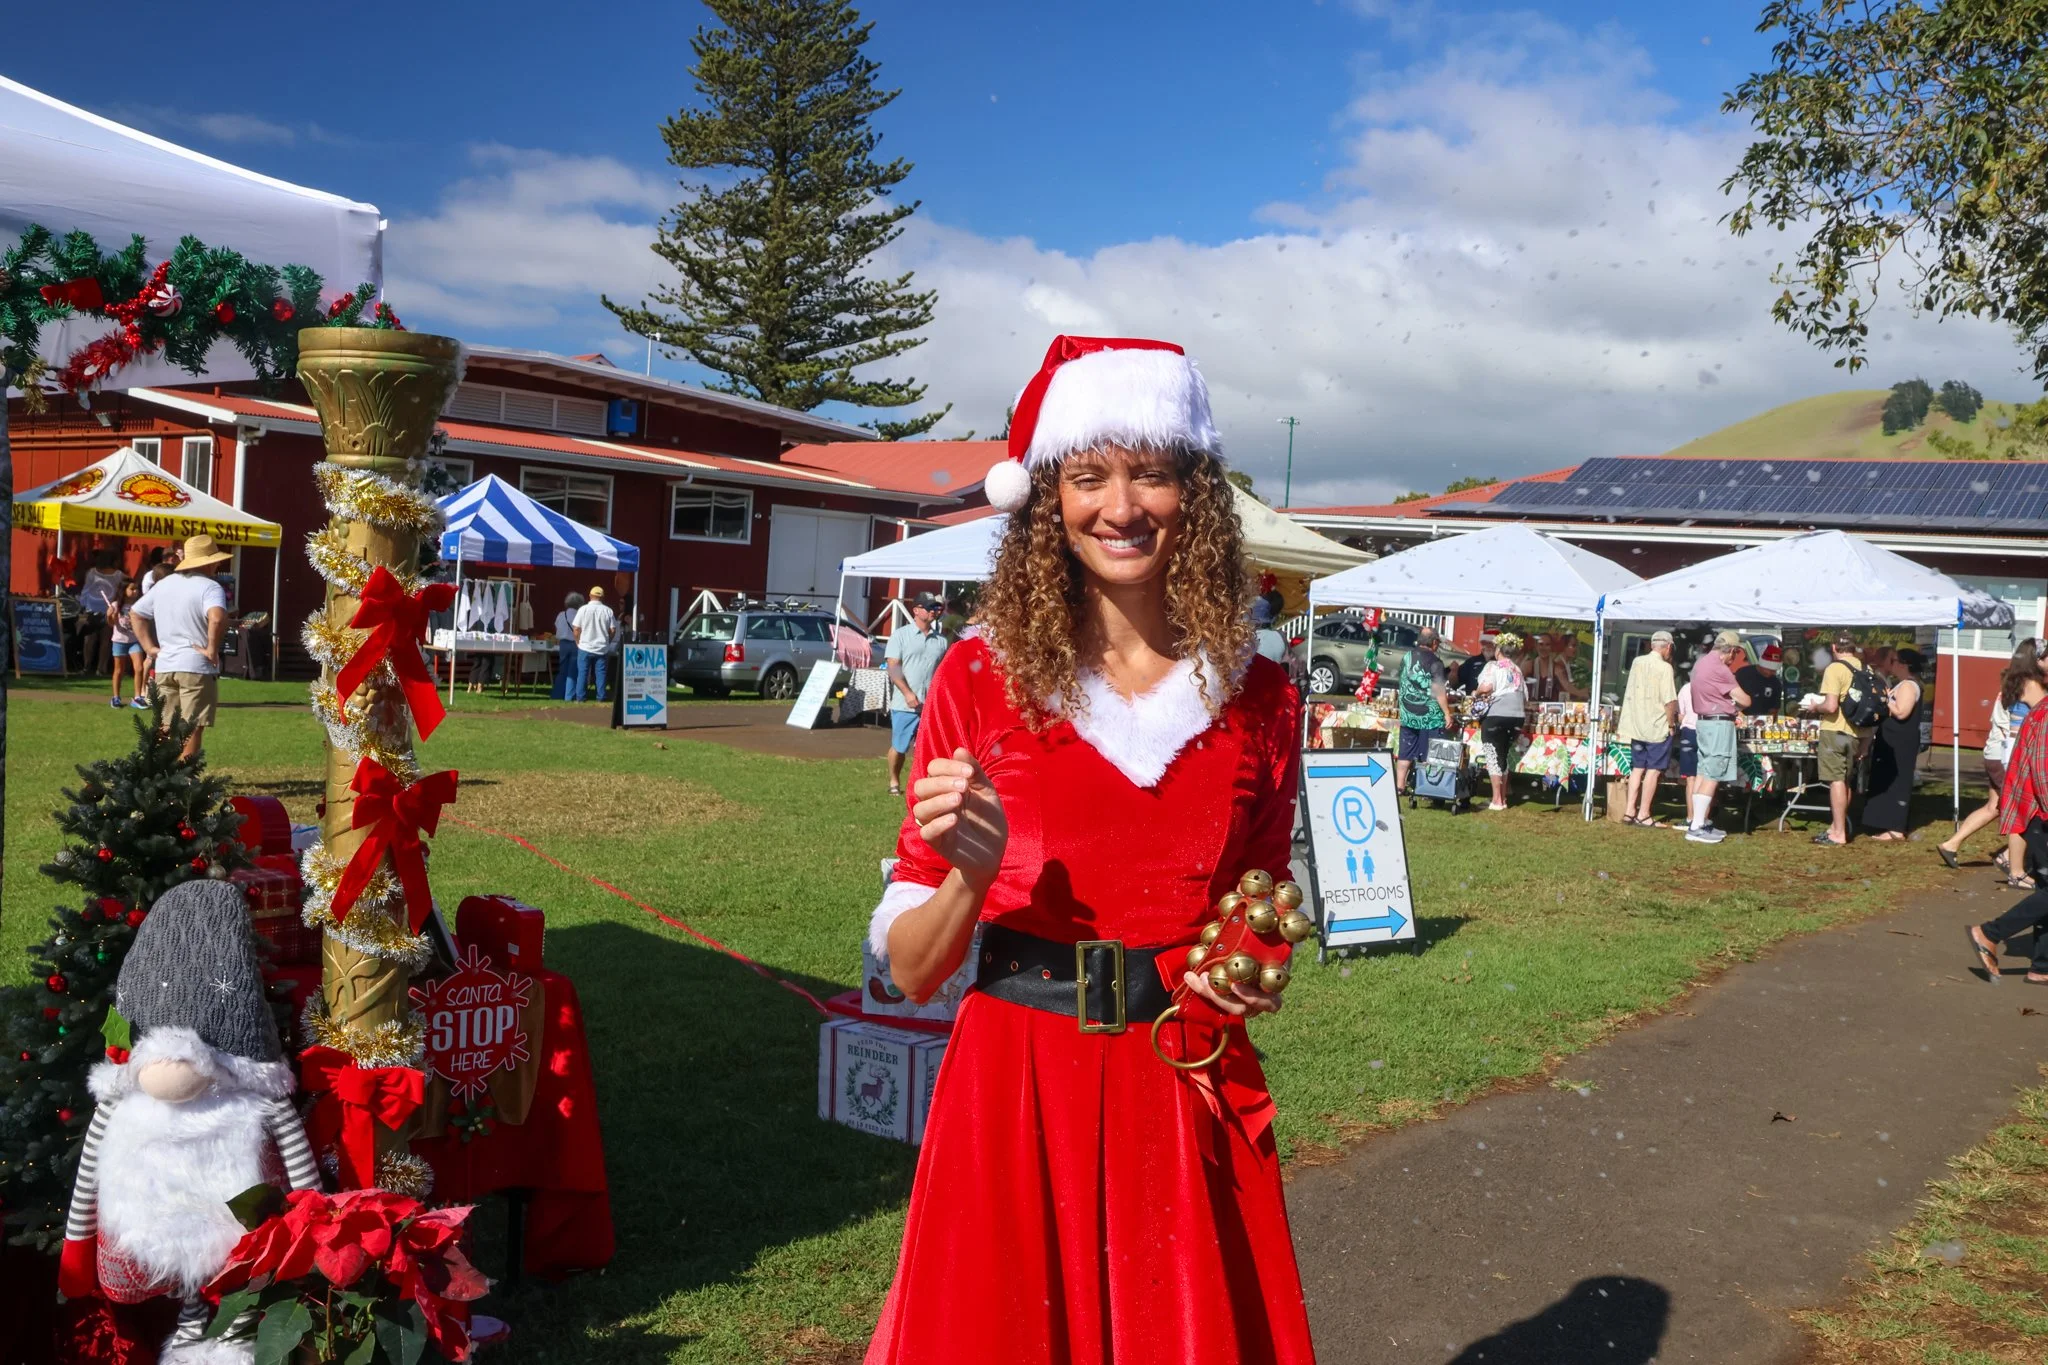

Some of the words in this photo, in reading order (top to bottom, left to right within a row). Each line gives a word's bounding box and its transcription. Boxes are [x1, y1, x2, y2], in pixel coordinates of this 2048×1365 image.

[28, 505, 46, 524] SALT
[95, 511, 174, 536] HAWAIIAN
[181, 519, 209, 537] SEA
[215, 523, 252, 542] SALT
[625, 647, 666, 669] KONA
[1342, 797, 1367, 830] R
[1325, 885, 1405, 904] RESTROOMS
[432, 1005, 514, 1052] STOP
[450, 1050, 494, 1073] HERE
[847, 1044, 899, 1065] REINDEER
